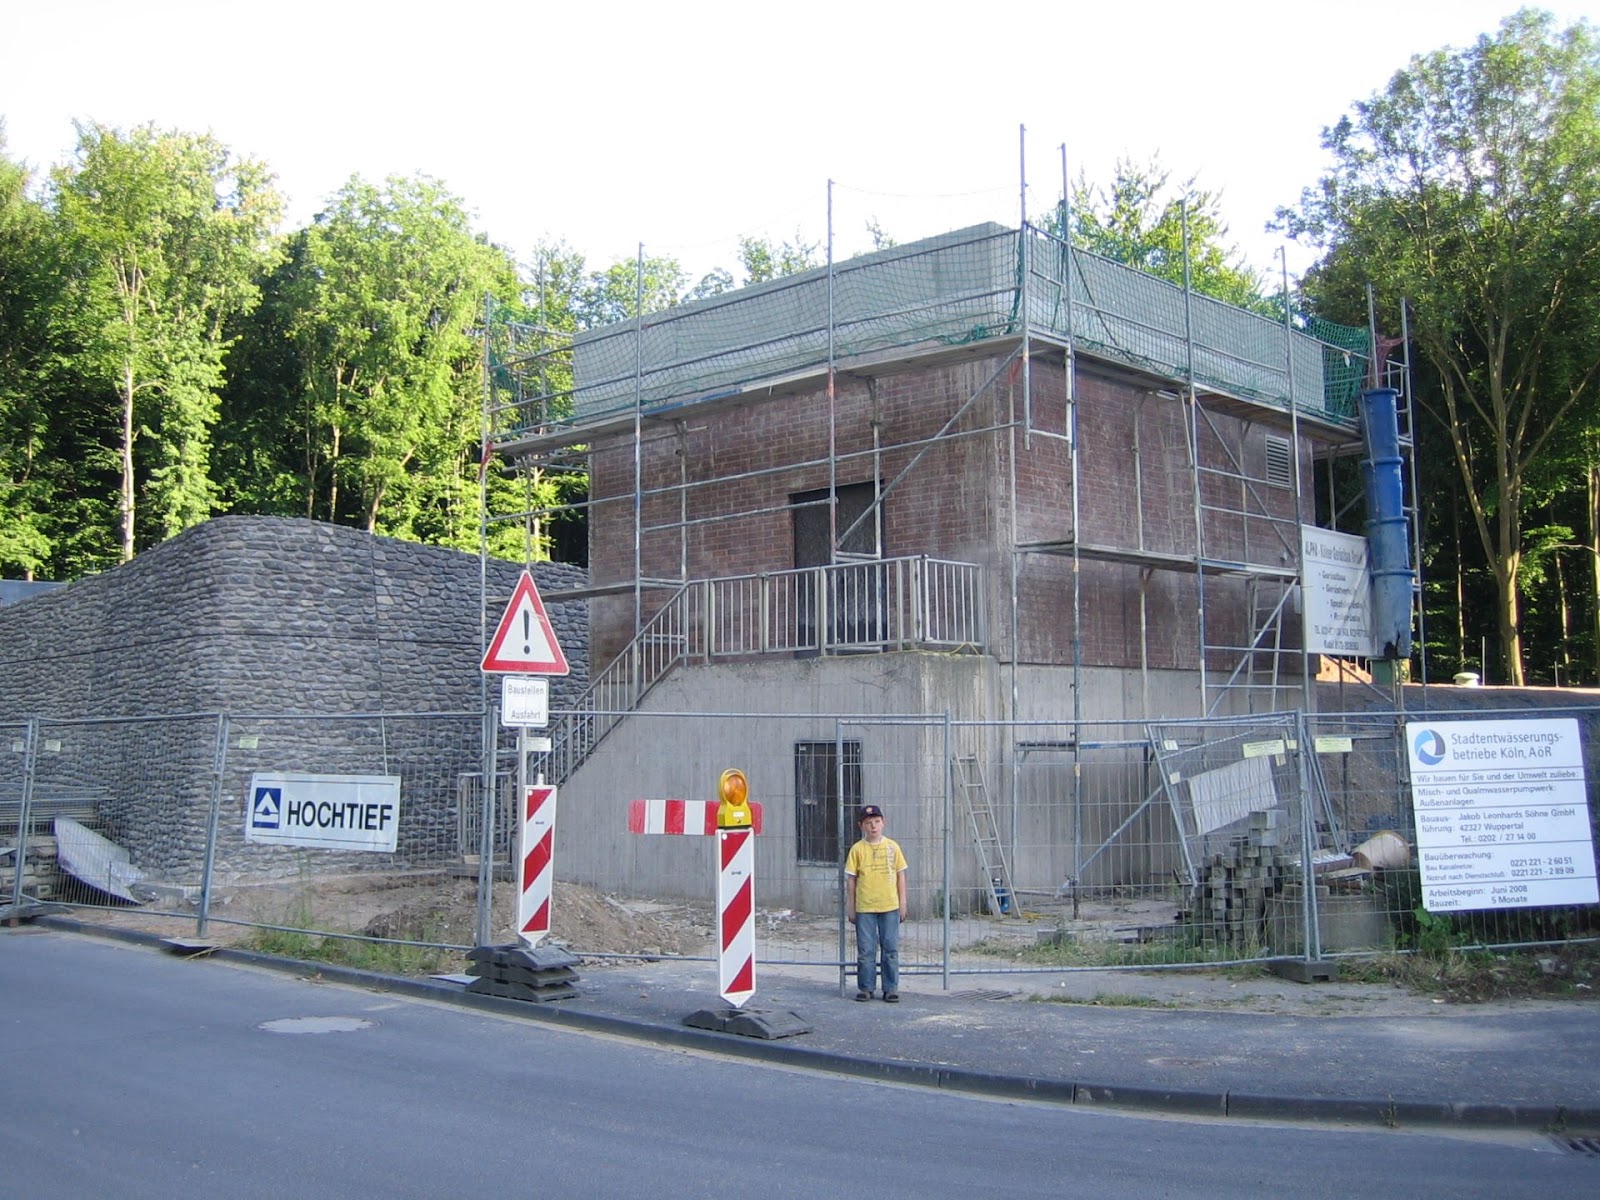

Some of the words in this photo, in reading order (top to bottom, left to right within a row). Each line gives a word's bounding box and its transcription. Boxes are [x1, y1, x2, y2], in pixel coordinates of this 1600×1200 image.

[508, 684, 544, 695] Baustellen
[510, 709, 540, 720] Ausfahrt
[1451, 731, 1564, 746] Stadtentwässerungs-
[1452, 749, 1496, 760] betriebe
[1500, 747, 1526, 760] Köln,
[1529, 746, 1552, 758] AöR
[1417, 775, 1430, 783] Wir
[1434, 774, 1456, 782] bauen
[1458, 773, 1470, 781] für
[1472, 772, 1484, 781] Sie
[1487, 772, 1500, 780] und
[1503, 772, 1515, 780] der
[1518, 771, 1547, 780] Umwelt
[1447, 787, 1461, 795] und
[1420, 798, 1475, 808] Außenanlagen
[287, 800, 393, 831] HOCHTIEF
[1458, 813, 1481, 822] Jakob
[1483, 810, 1523, 820] Leonhards
[1525, 809, 1549, 818] Söhne
[1550, 808, 1576, 817] GmbH
[1484, 822, 1524, 832] Wuppertal
[1478, 834, 1496, 842] 0202
[1505, 833, 1514, 842] 27
[1424, 852, 1495, 862] Bauüberwachung:
[1510, 858, 1528, 868] 0221
[1530, 858, 1542, 866] 221
[1564, 856, 1573, 865] 51
[1511, 868, 1530, 878] 0221
[1530, 868, 1543, 877] 221
[1429, 888, 1486, 898] Arbeitsbeginn:
[1490, 886, 1508, 894] Juni
[1509, 885, 1528, 894] 2008
[1429, 898, 1462, 908] Bauzeit:
[1498, 896, 1528, 904] Monate
